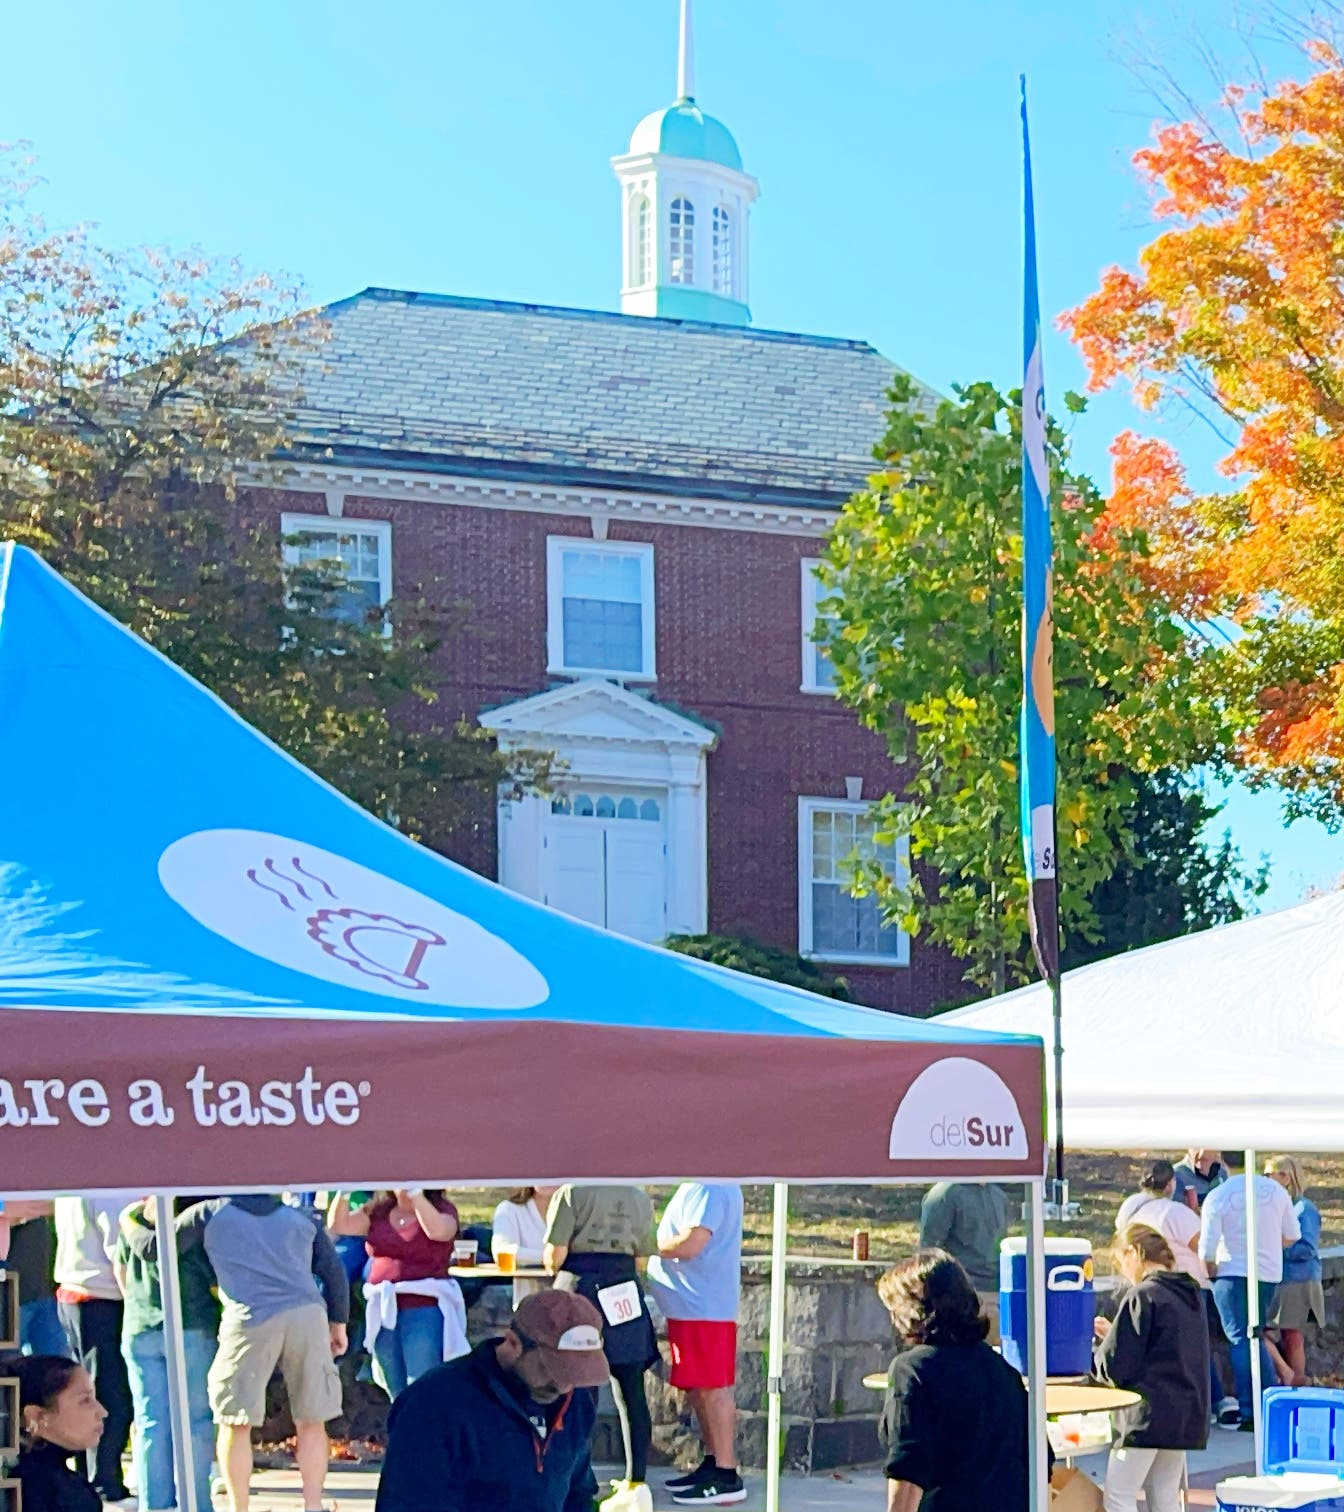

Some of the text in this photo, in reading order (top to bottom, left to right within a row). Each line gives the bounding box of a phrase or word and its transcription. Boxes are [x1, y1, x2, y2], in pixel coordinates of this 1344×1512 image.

[128, 1079, 175, 1127] a
[930, 1116, 1014, 1148] delSur
[613, 1298, 633, 1321] 30
